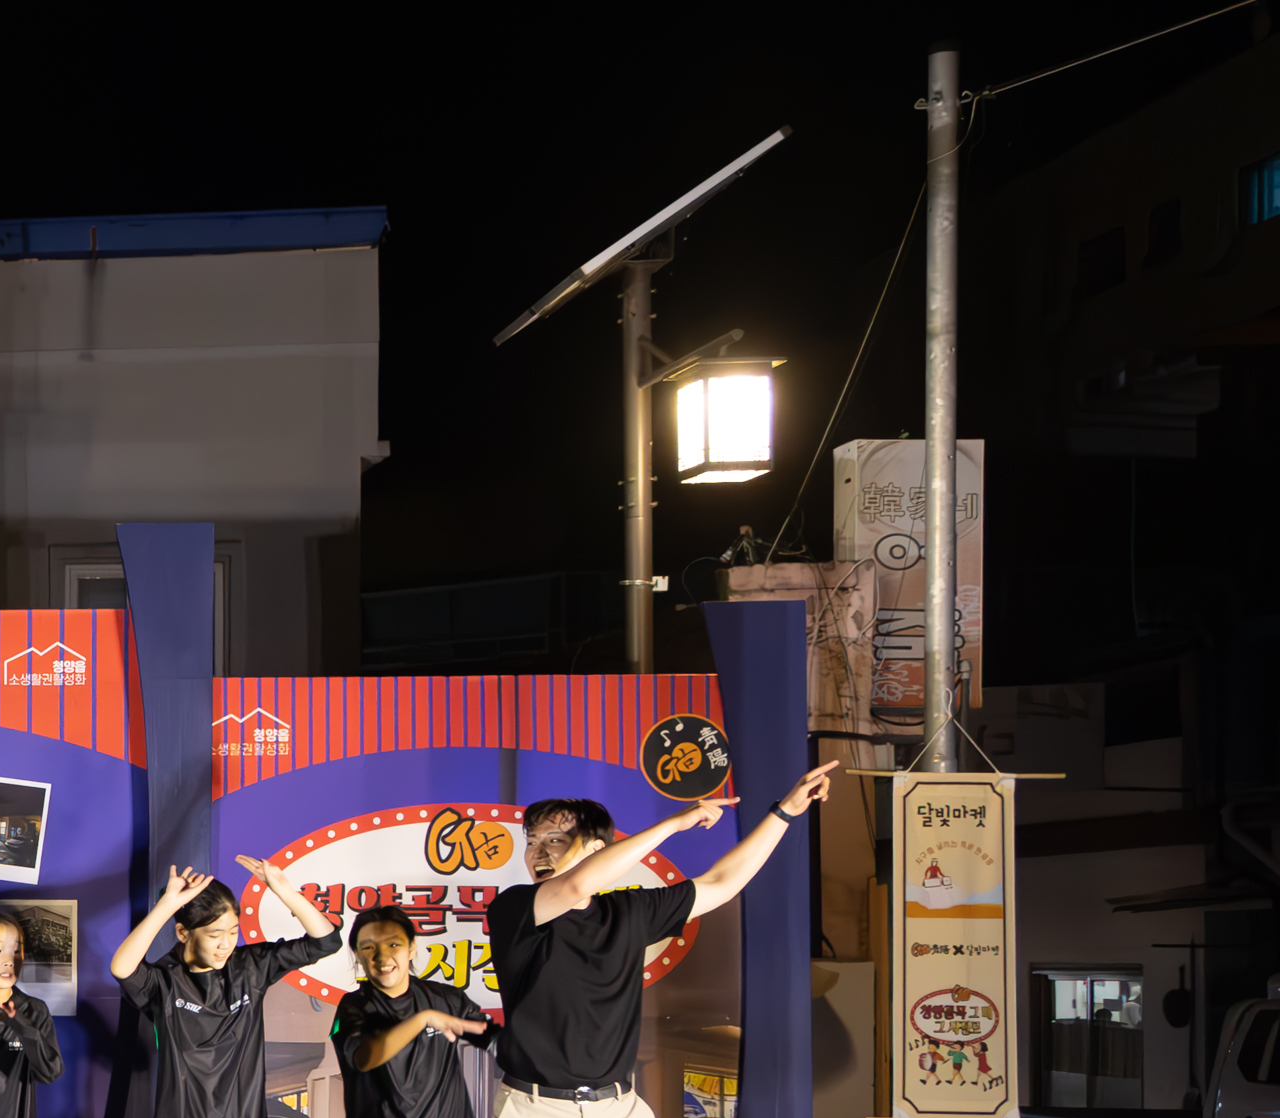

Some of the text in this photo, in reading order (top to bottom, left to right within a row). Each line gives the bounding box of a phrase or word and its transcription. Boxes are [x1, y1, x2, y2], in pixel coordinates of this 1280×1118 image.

[52, 660, 86, 674] 청양읍
[253, 728, 290, 743] 청양읍
[917, 802, 986, 828] 달빛마켓
